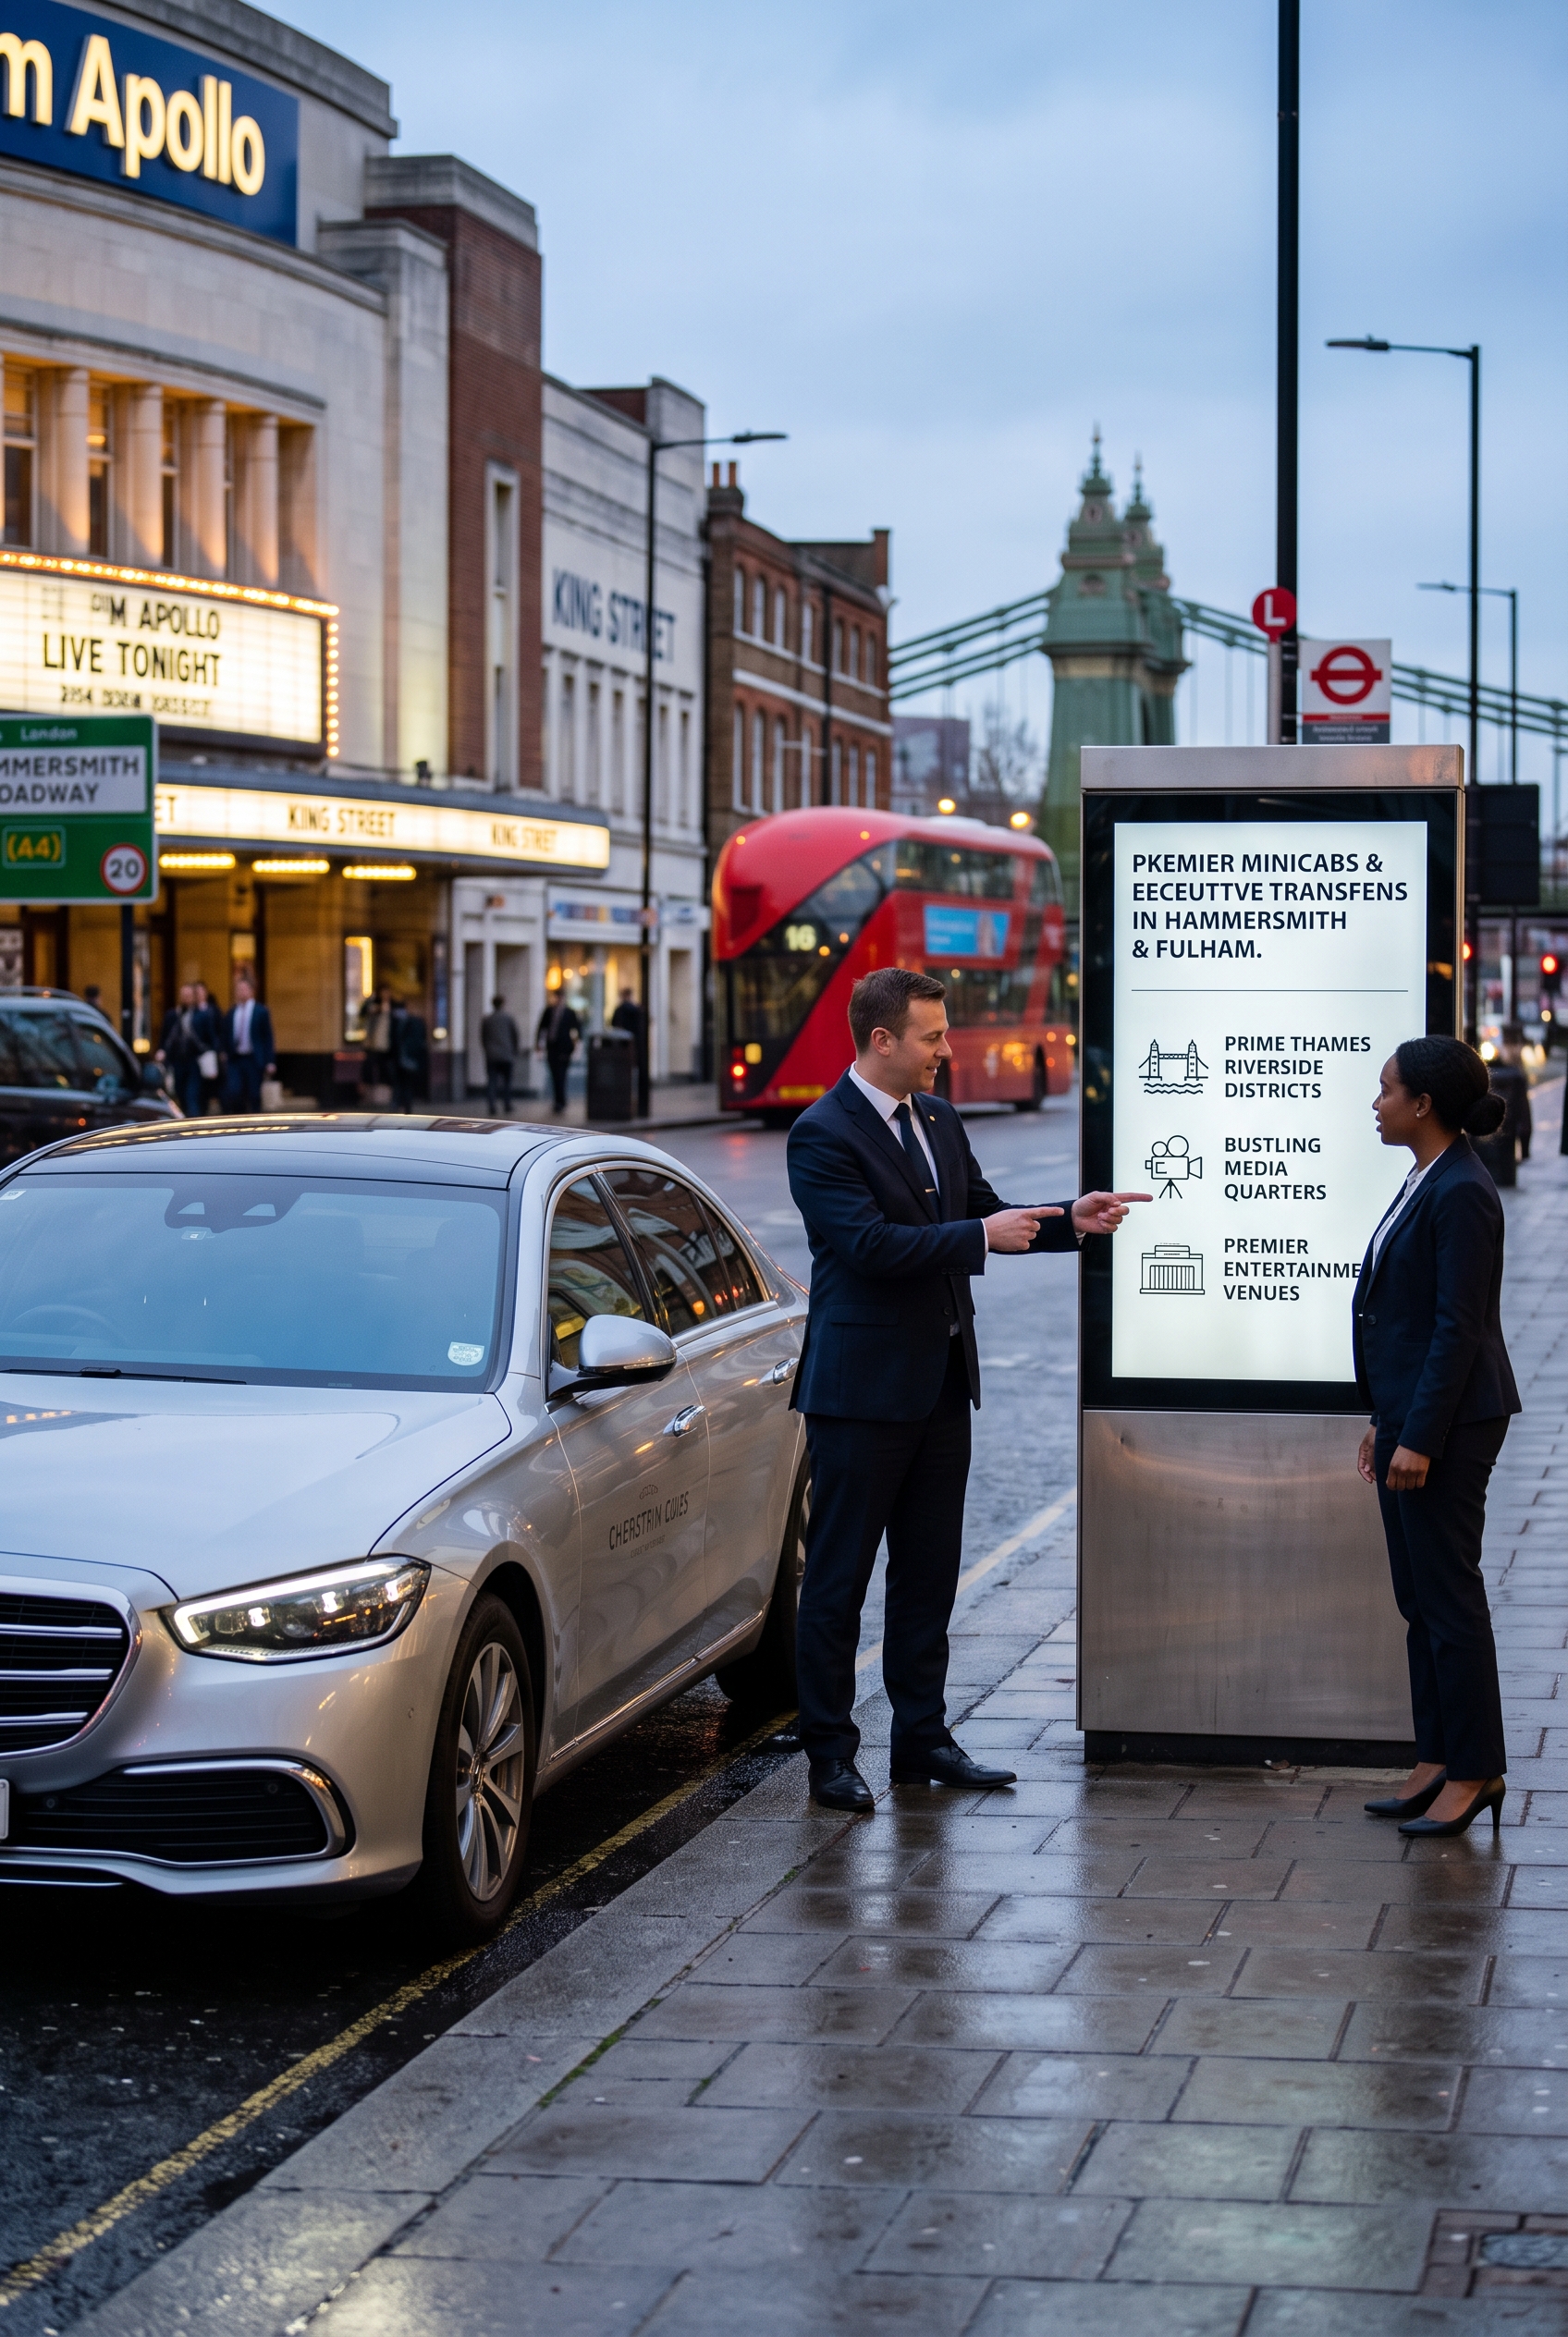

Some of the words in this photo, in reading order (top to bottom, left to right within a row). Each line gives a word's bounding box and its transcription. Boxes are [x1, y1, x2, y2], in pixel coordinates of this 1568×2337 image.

[65, 34, 265, 196] Apollo
[1264, 594, 1286, 626] L
[141, 601, 221, 640] APOLLO
[43, 633, 103, 673] LIVE
[117, 642, 220, 686] TONIGHT
[338, 808, 394, 838] STREET
[6, 834, 61, 862] (A4)
[110, 859, 139, 878] 20
[1133, 854, 1234, 872] PKEMIER
[1243, 853, 1359, 872] MINICABS
[1366, 853, 1383, 872] &
[1133, 883, 1263, 900] EECEUTTVE
[1269, 883, 1408, 900] TRANSFENS
[1133, 912, 1157, 929] IN
[1166, 912, 1346, 929] HAMMERSMITH
[1133, 940, 1149, 958] &
[1157, 940, 1262, 958] FULHAM.
[1225, 1036, 1284, 1051] PRIME
[1291, 1037, 1371, 1052] THAMES
[1225, 1059, 1324, 1074] RIVERSIDE
[1225, 1083, 1322, 1098] DISTRICTS
[1225, 1138, 1321, 1153] BUSTLING
[1225, 1161, 1288, 1176] MEDIA
[1224, 1184, 1326, 1202] QUARTERS
[1224, 1239, 1309, 1254] PREMIER
[1224, 1262, 1361, 1278] ENTERTAINME
[1223, 1285, 1300, 1301] VENUES
